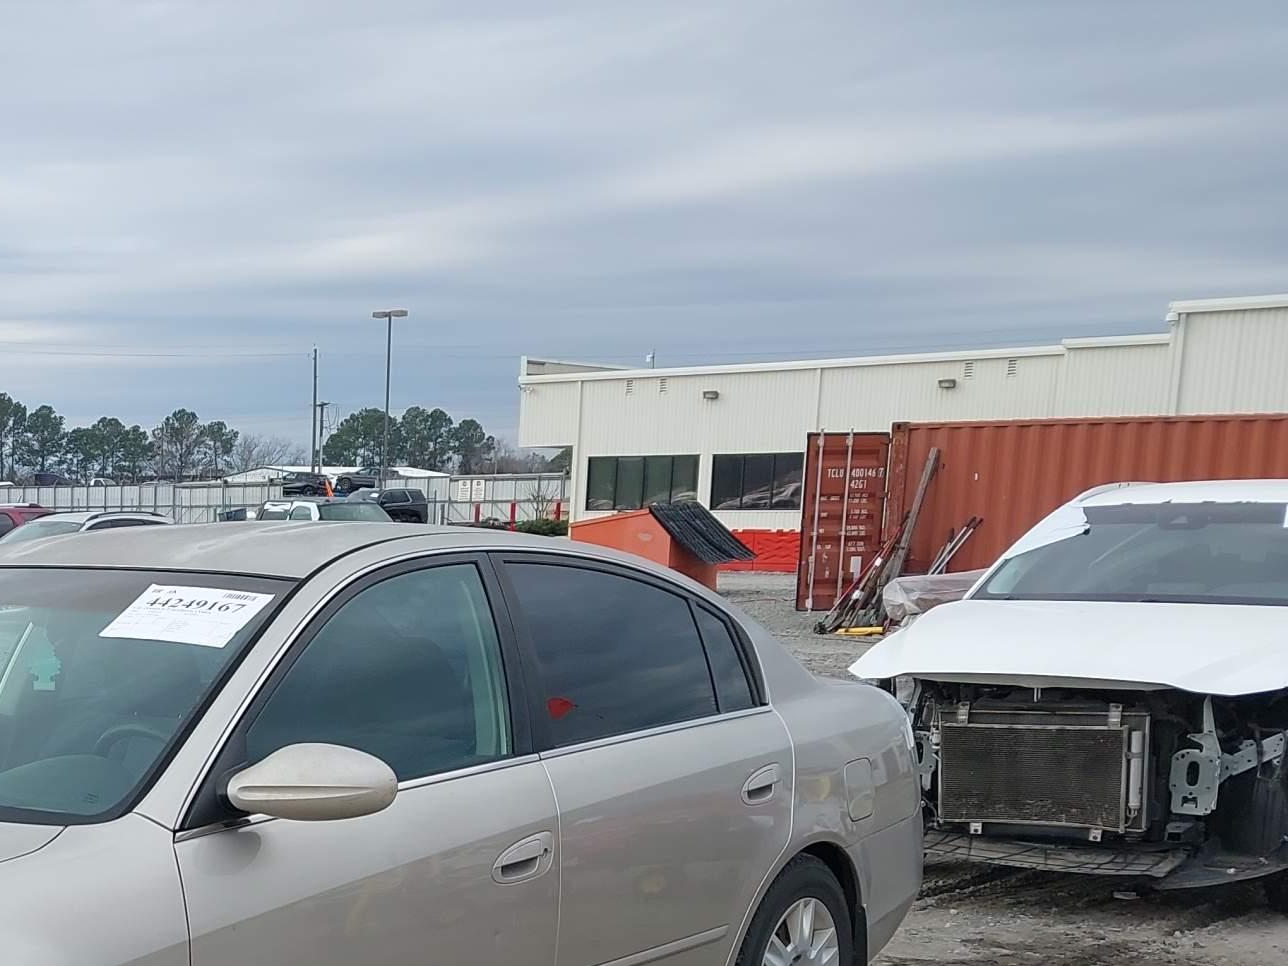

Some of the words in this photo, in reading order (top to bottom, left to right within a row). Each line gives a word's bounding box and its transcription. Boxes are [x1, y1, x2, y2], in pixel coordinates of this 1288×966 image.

[827, 468, 844, 478] TCLU
[851, 468, 876, 477] 400146
[146, 597, 247, 613] 44249167
